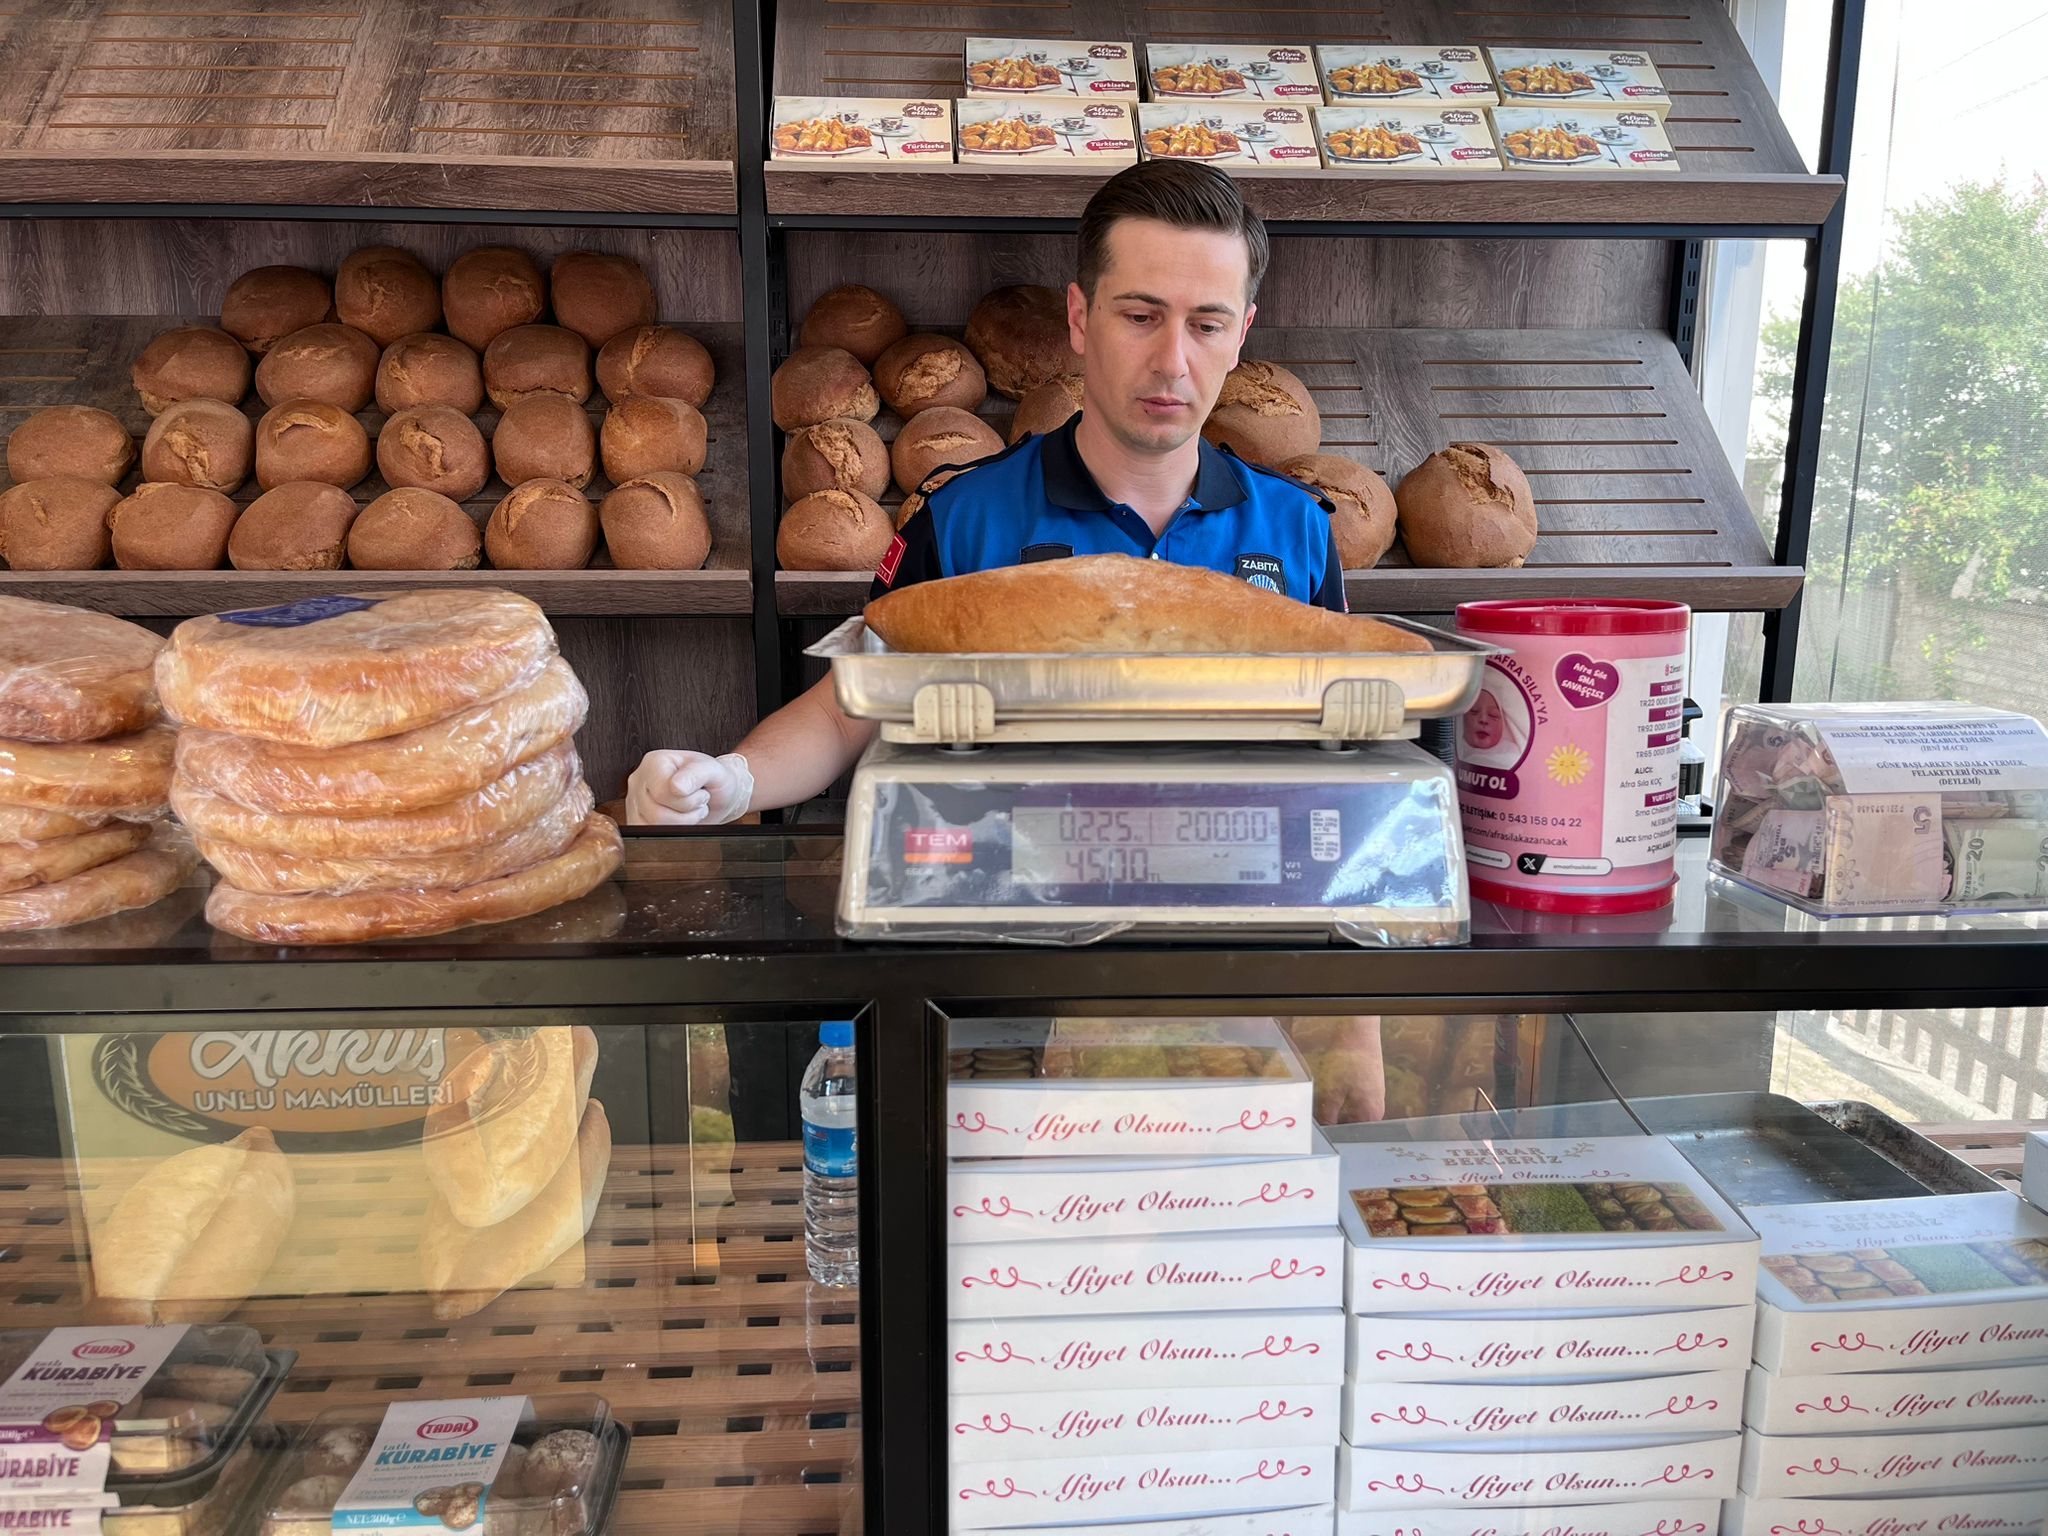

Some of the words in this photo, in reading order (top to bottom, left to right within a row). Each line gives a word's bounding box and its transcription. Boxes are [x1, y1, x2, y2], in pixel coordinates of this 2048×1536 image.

[1241, 560, 1280, 573] ZABITA
[1577, 674, 1595, 687] SMA
[1876, 760, 1901, 769] GÜNE
[1954, 760, 1988, 768] SADAKA
[1488, 776, 1508, 791] OL
[1508, 813, 1527, 824] 543
[1530, 815, 1548, 826] 158
[1551, 817, 1566, 827] 04
[1568, 818, 1583, 828] 22
[911, 833, 968, 847] TEM
[1966, 838, 1985, 862] 20
[194, 1088, 277, 1113] UNLU
[284, 1080, 454, 1112] MAMÜLLERİ
[22, 1363, 147, 1381] KURABİYE
[425, 1420, 470, 1435] TADAL
[375, 1441, 498, 1466] KURABİYE
